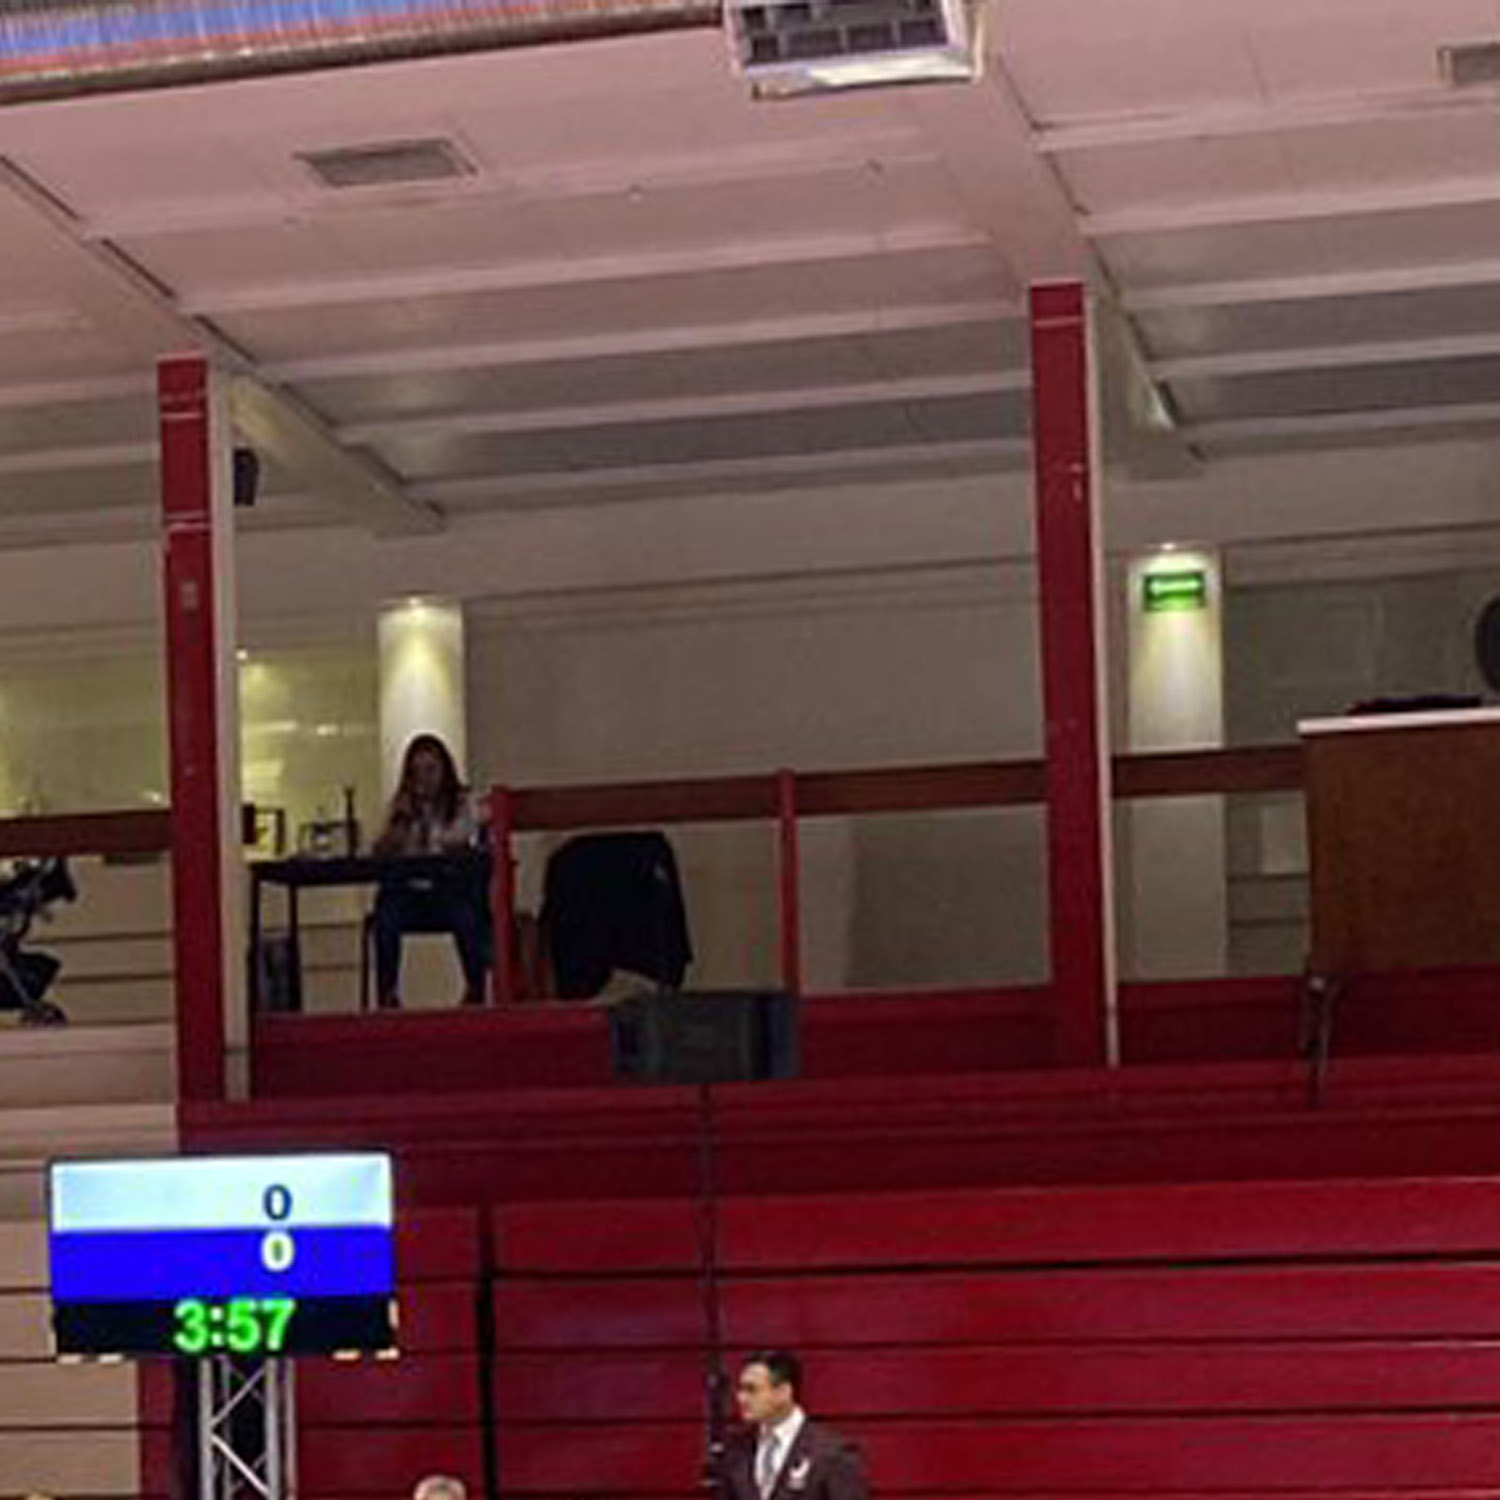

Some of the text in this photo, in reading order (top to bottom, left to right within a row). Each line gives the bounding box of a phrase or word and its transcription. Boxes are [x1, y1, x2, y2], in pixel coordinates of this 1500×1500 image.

[263, 1184, 293, 1220] 0
[261, 1231, 295, 1272] 0
[174, 1298, 296, 1352] 3:57
